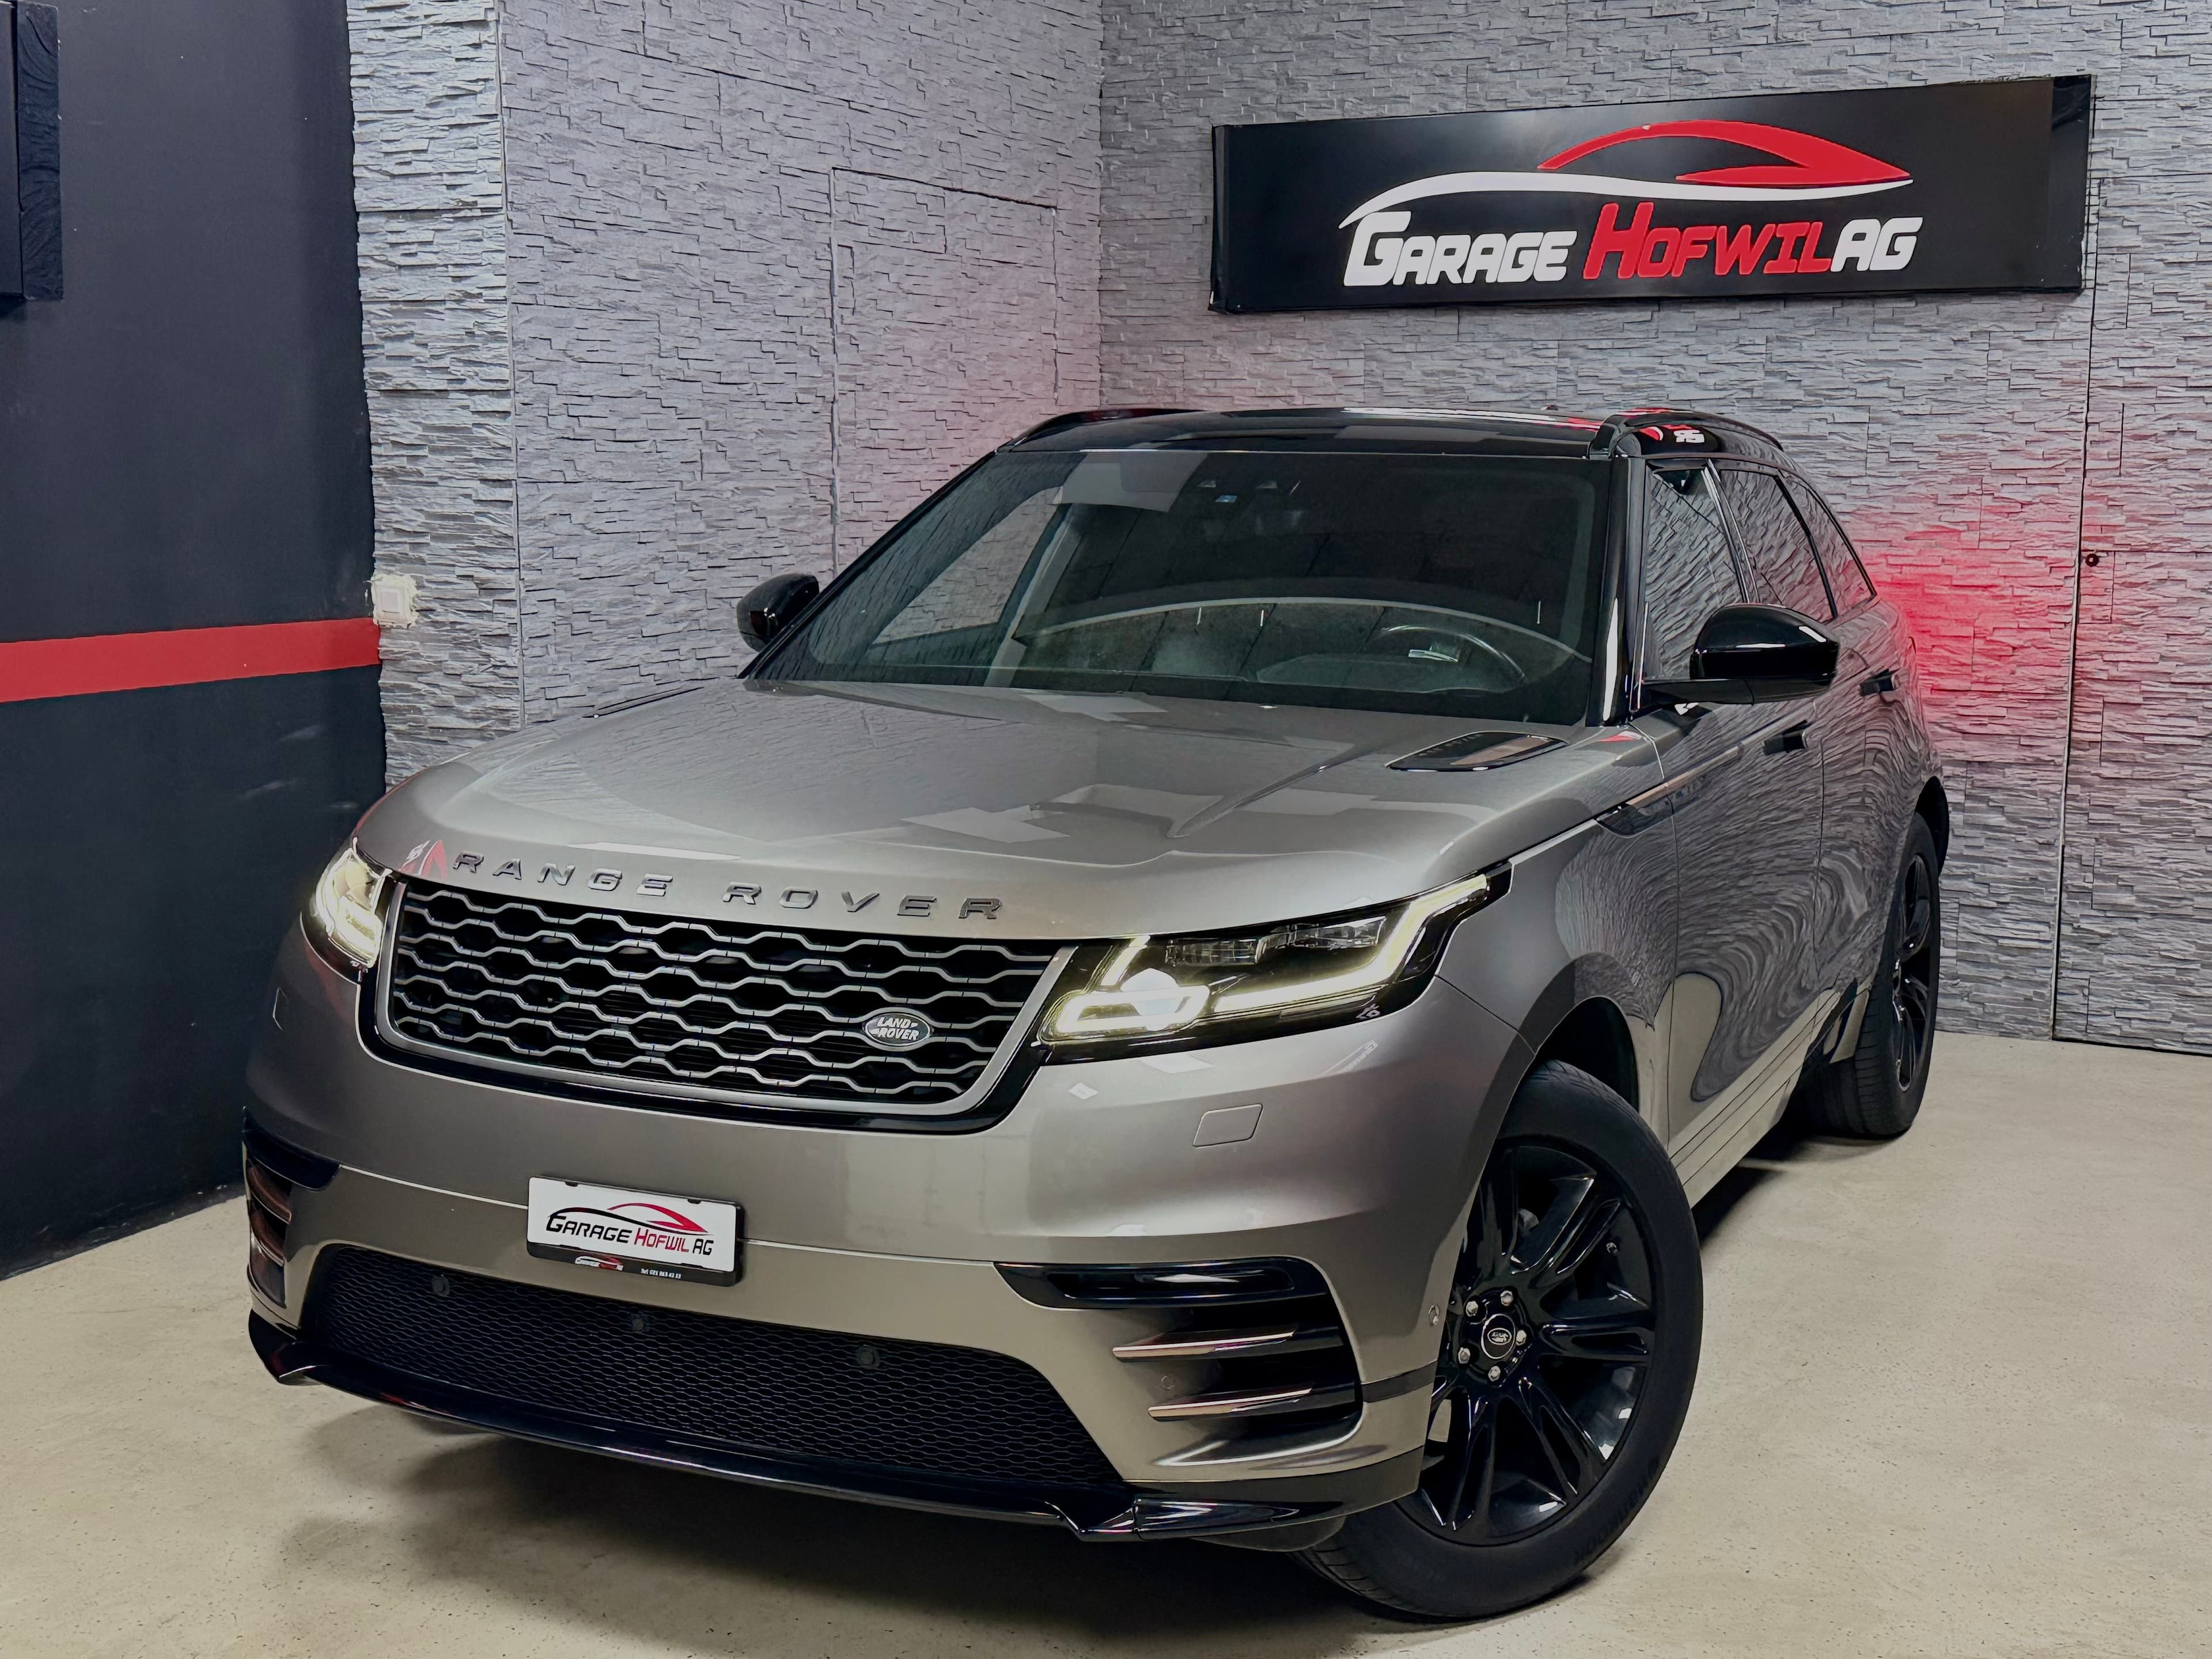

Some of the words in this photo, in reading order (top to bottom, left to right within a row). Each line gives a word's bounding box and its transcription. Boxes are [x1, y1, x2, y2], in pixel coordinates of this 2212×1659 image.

[1343, 211, 1577, 286] GARAGE
[453, 851, 673, 896] RANGE
[722, 881, 1003, 919] ROVER
[878, 1027, 919, 1040] ROVER
[546, 1215, 632, 1244] GARAGE
[634, 1228, 690, 1252] HOFWIL
[692, 1238, 714, 1255] AG
